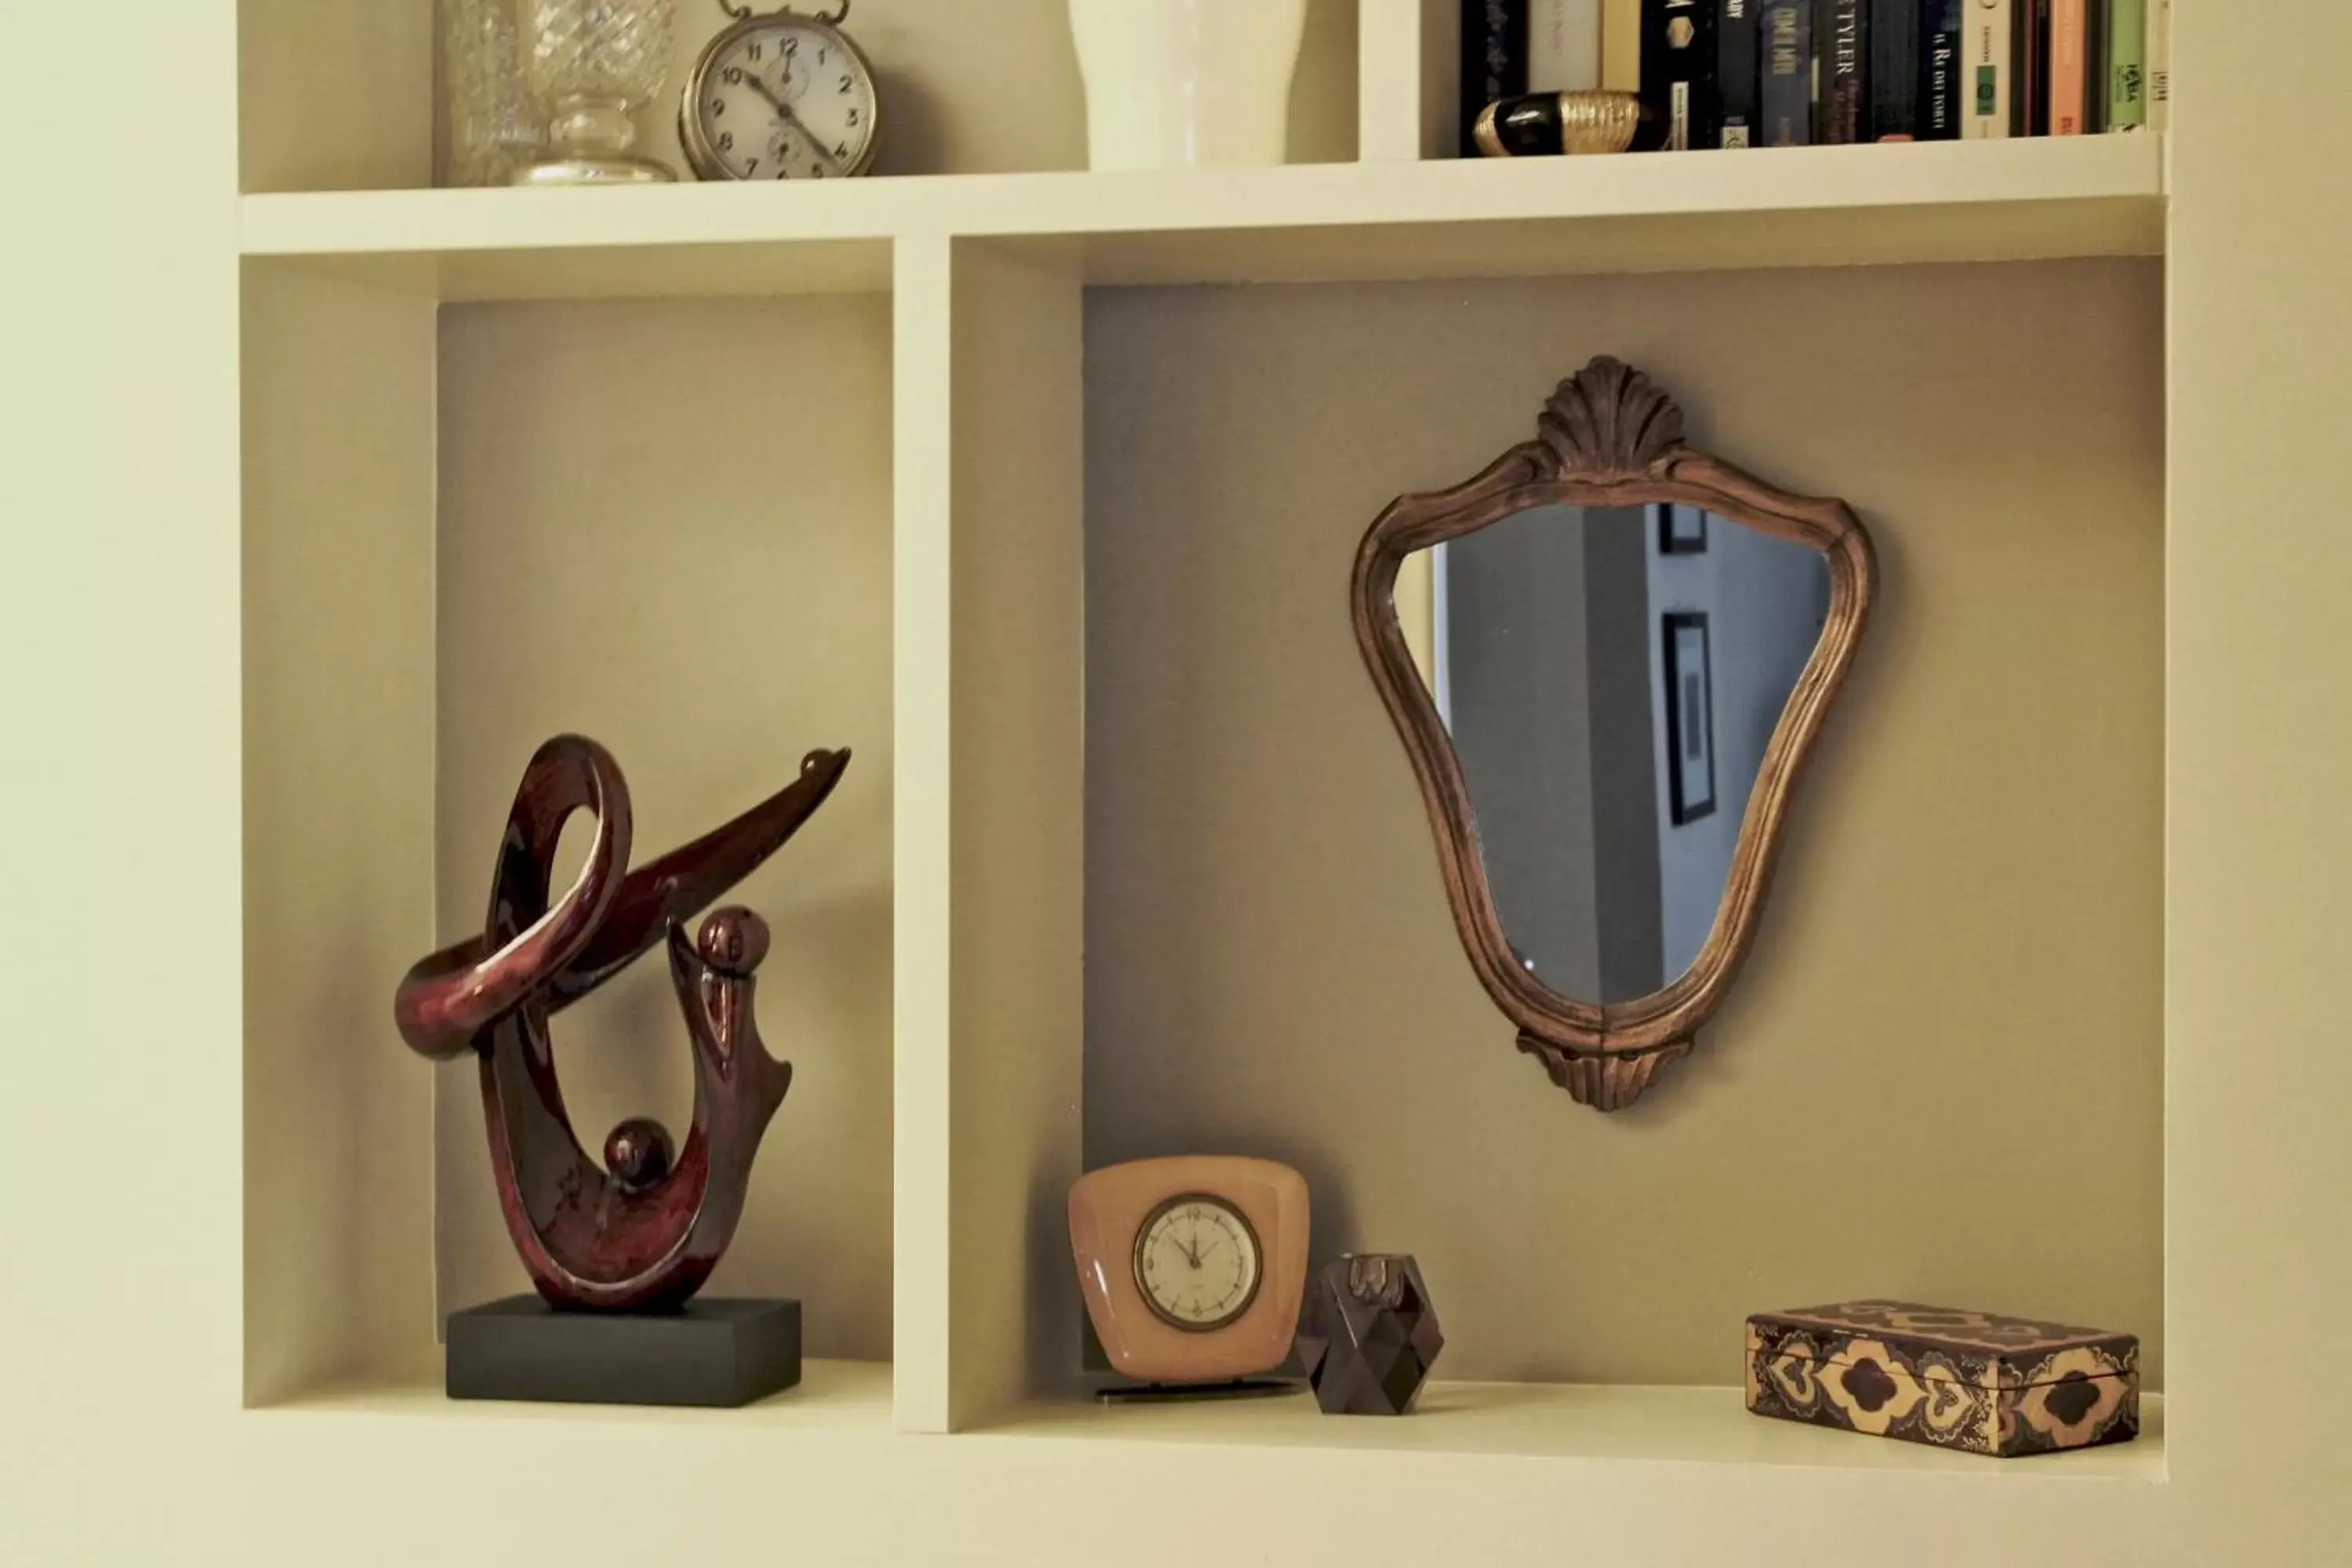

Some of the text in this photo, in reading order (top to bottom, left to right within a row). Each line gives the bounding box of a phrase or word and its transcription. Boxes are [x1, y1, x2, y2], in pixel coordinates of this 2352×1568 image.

[779, 38, 798, 56] 12
[1836, 7, 1856, 74] TYLER
[748, 45, 760, 60] 11
[818, 49, 825, 66] 1
[721, 67, 742, 84] 10
[838, 75, 853, 93] 2
[712, 100, 724, 117] 9
[847, 108, 858, 125] 3
[717, 131, 733, 151] 8
[833, 140, 848, 158] 4
[745, 158, 759, 177] 7
